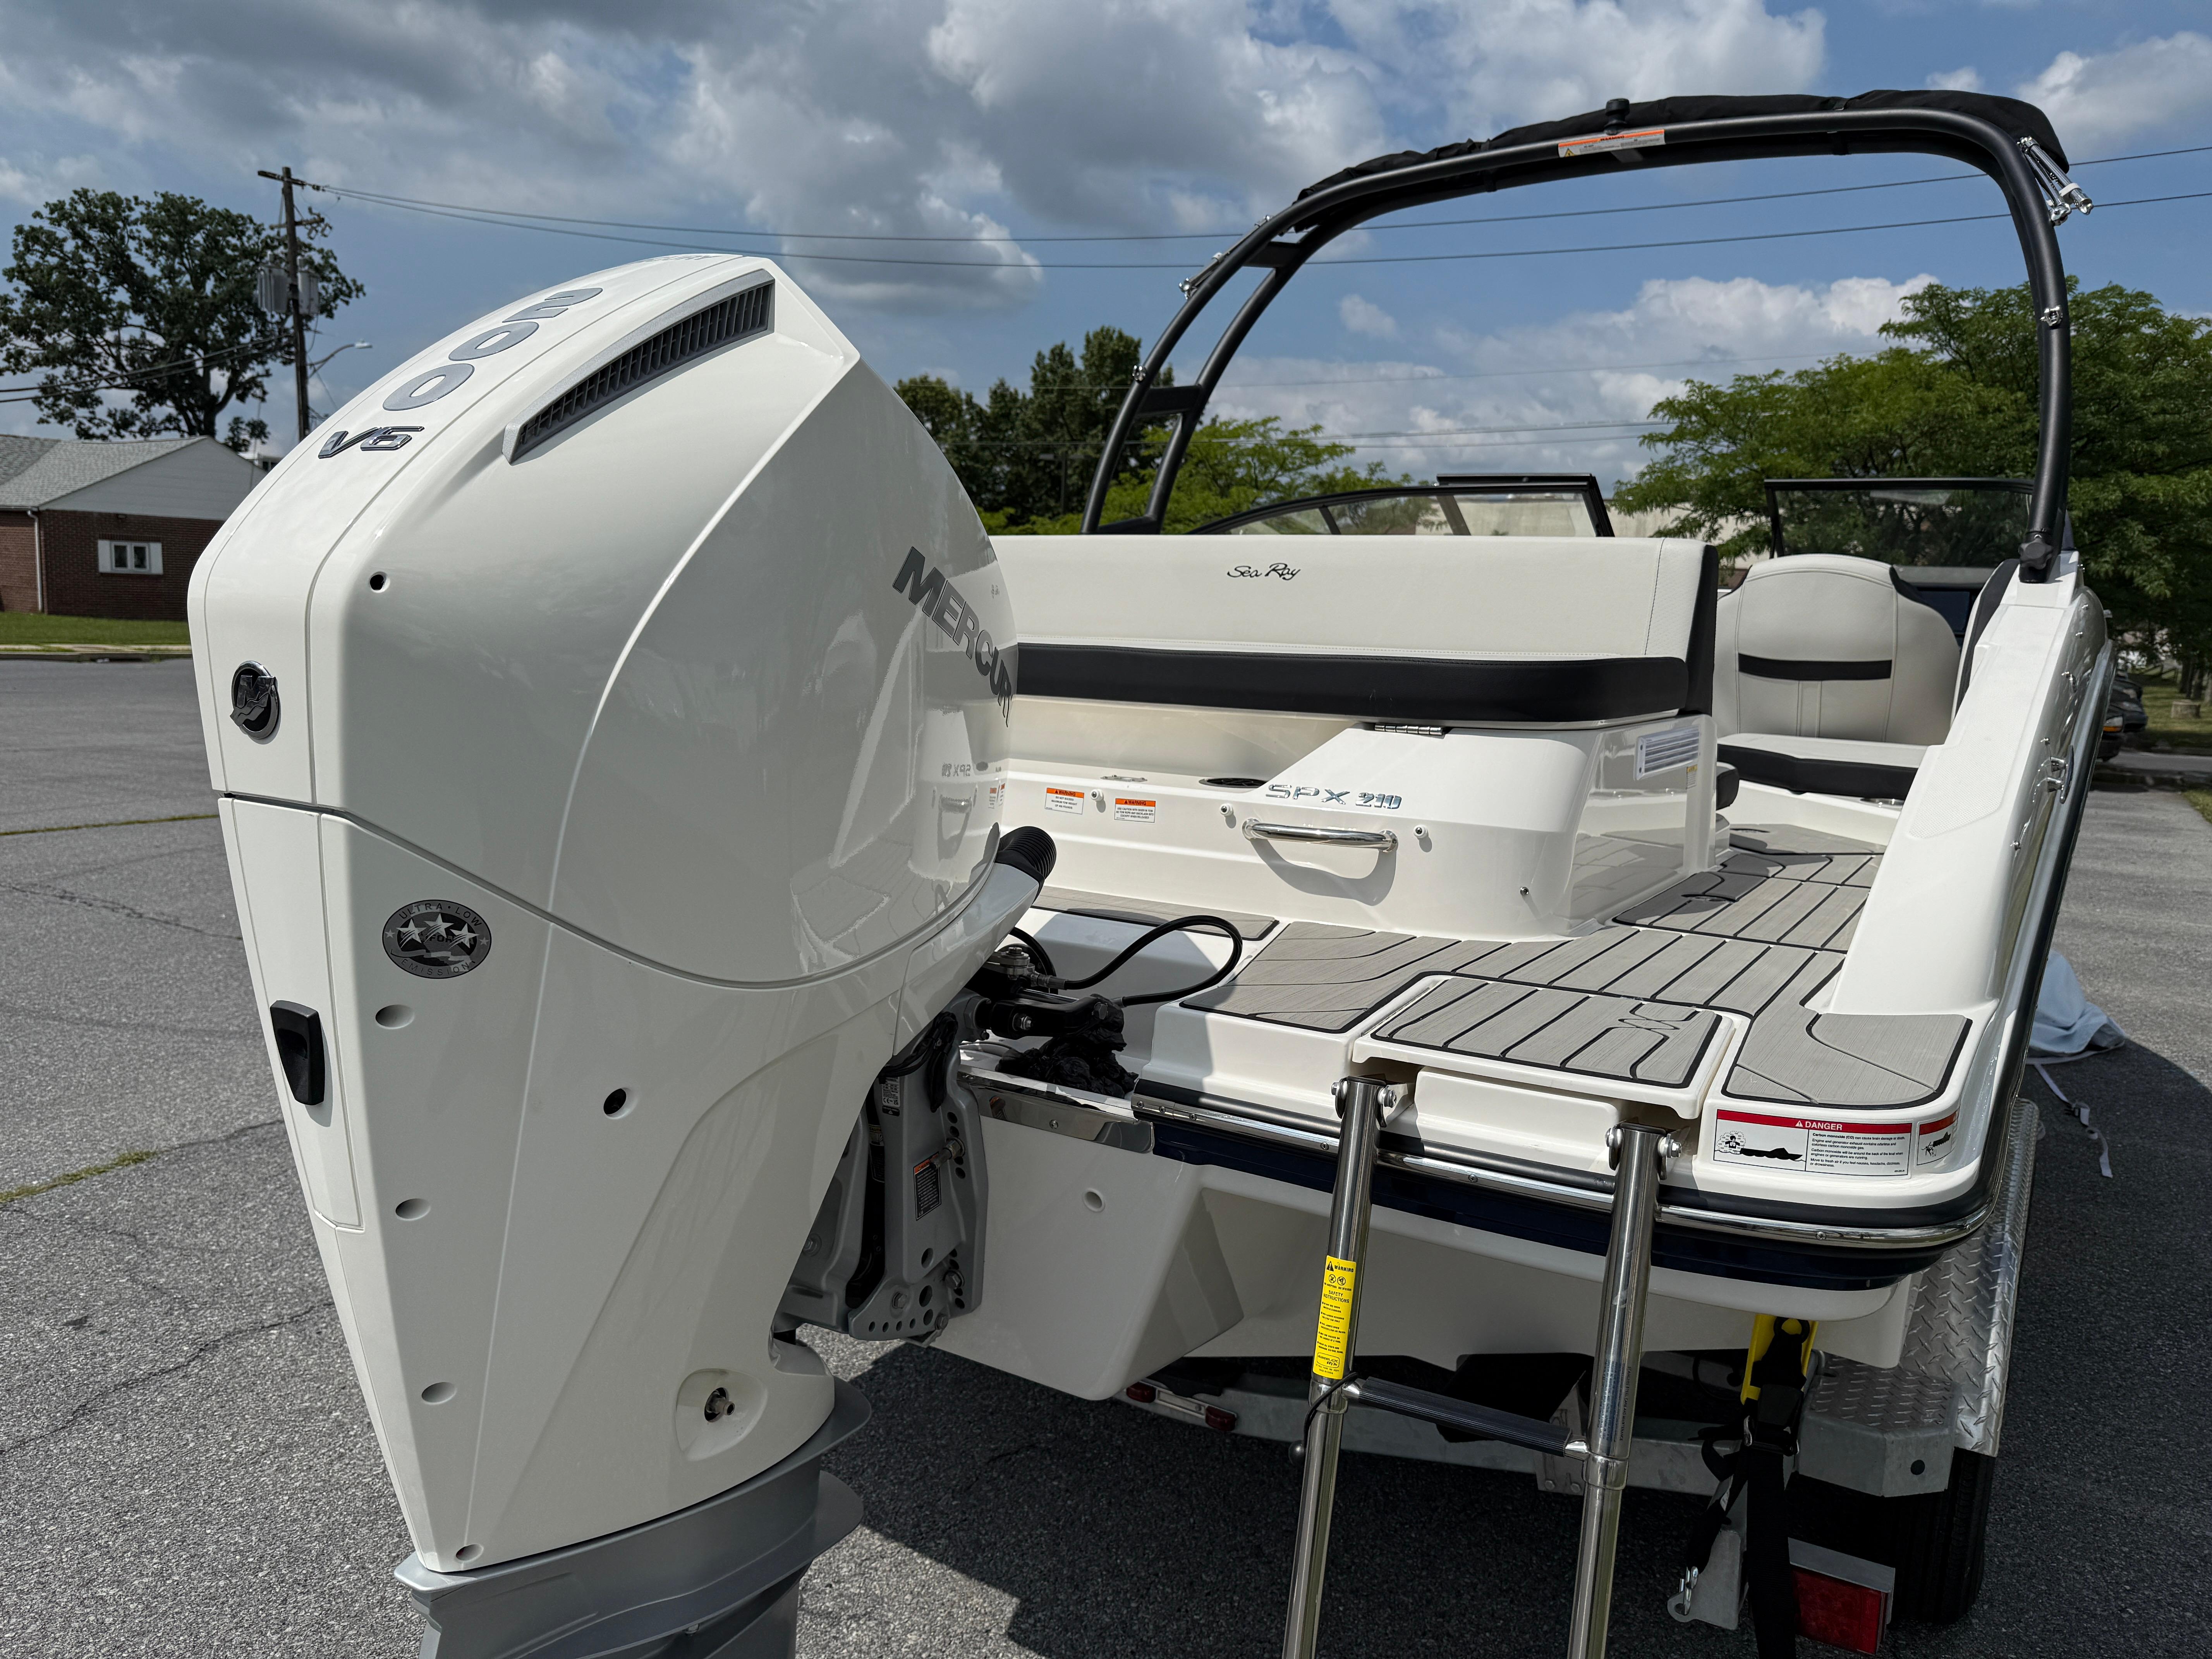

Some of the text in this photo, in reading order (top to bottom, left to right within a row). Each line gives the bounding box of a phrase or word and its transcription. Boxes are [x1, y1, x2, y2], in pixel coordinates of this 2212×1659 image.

[318, 426, 425, 459] V6
[1227, 563, 1301, 580] Sea Ray
[1265, 784, 1402, 809] SPX 210
[398, 902, 483, 927] ULTRA LOW
[401, 958, 470, 975] EMISSION
[1805, 1121, 1843, 1130] DANGER
